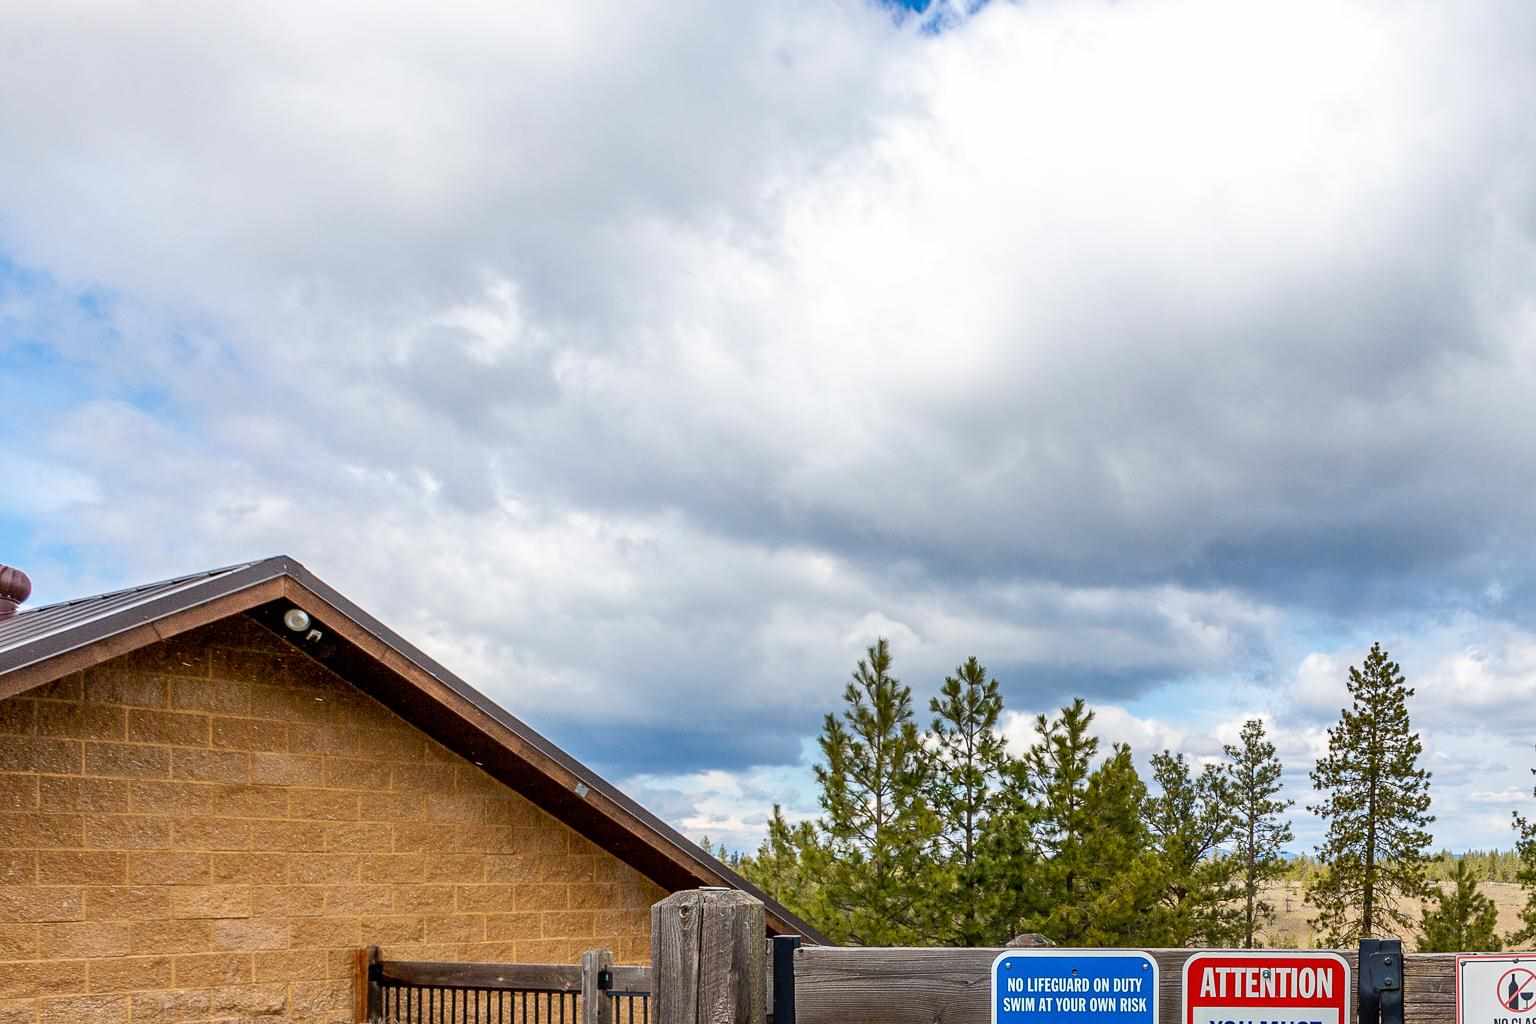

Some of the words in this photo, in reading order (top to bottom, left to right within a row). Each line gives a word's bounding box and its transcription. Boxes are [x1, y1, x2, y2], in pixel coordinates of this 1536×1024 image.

[1008, 978, 1023, 992] NO
[1028, 978, 1089, 992] LIFEGUARD
[1094, 978, 1109, 992] ON
[1114, 978, 1142, 992] DUTY
[1200, 967, 1332, 998] ATTENTION
[1004, 998, 1035, 1012] SWIM
[1039, 998, 1053, 1012] AT
[1056, 998, 1086, 1012] YOUR
[1090, 998, 1116, 1012] OWN
[1120, 998, 1146, 1012] RISK
